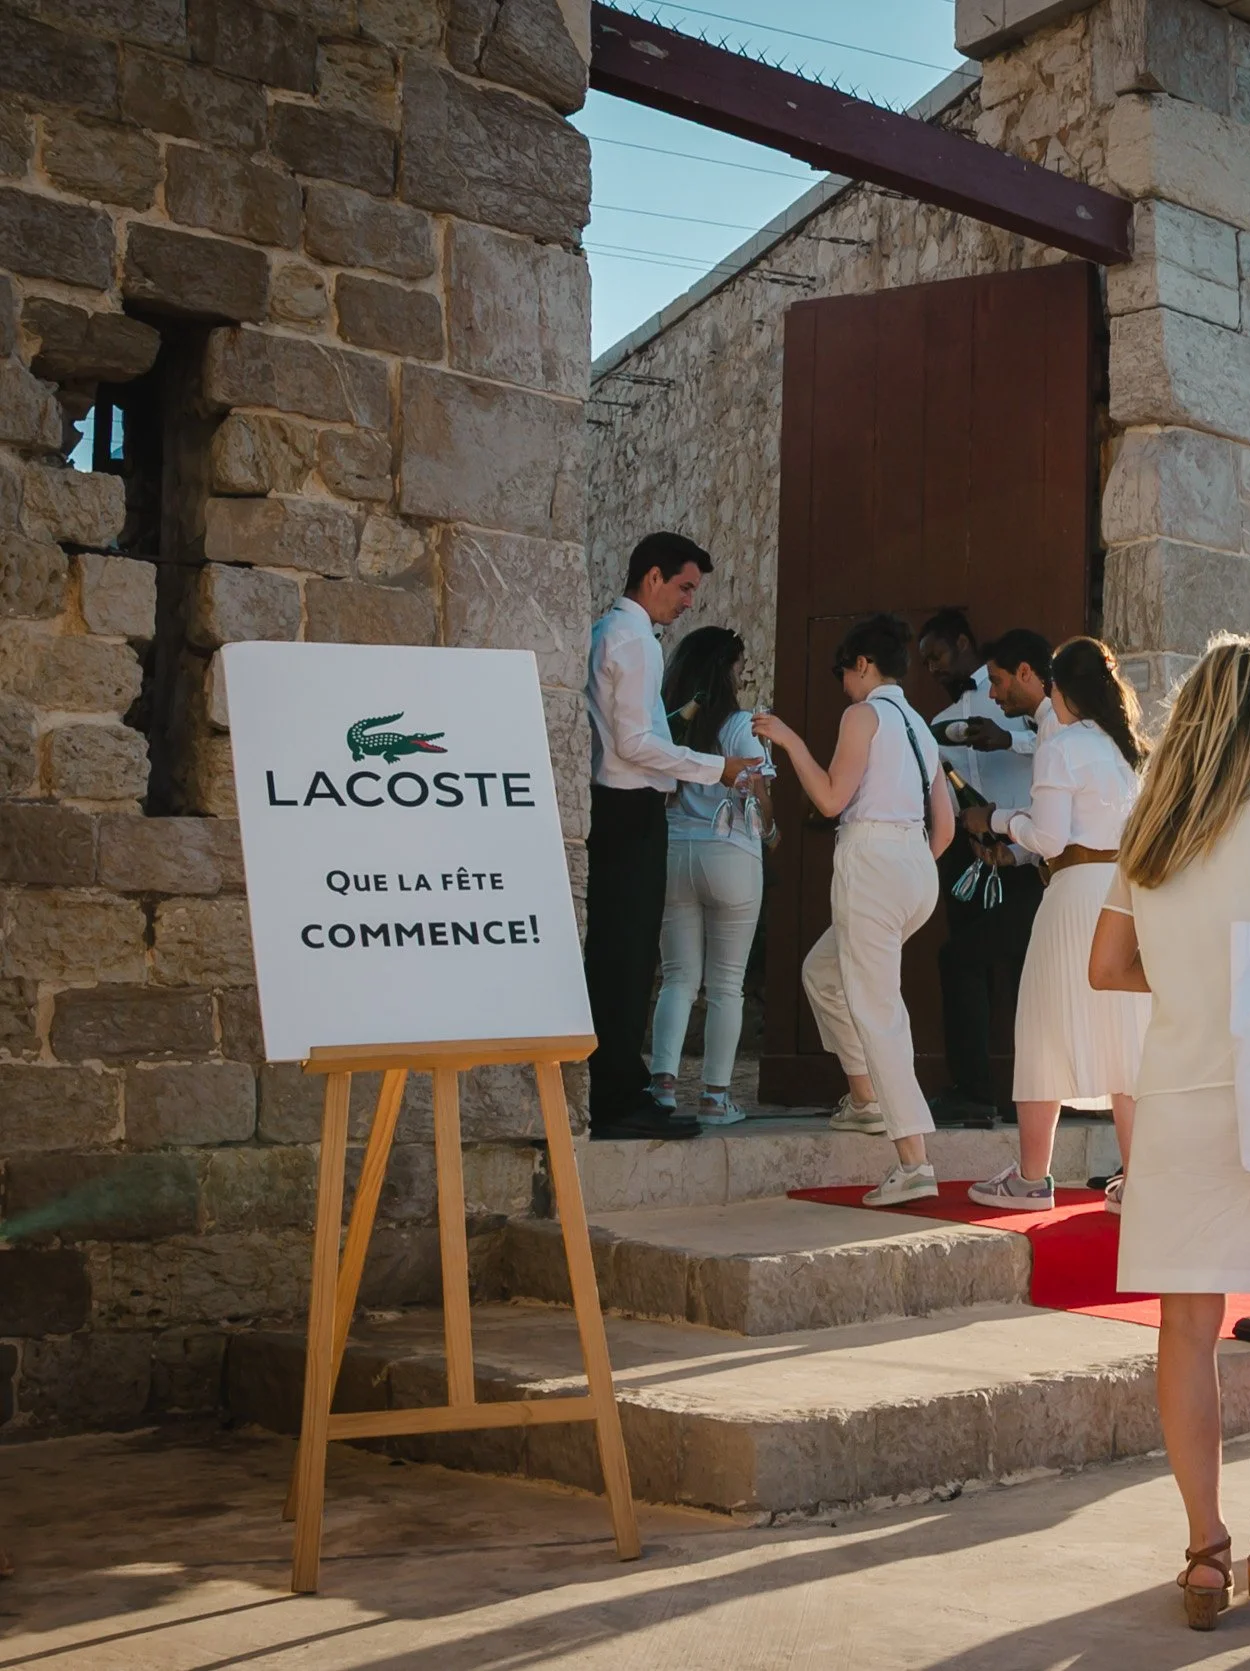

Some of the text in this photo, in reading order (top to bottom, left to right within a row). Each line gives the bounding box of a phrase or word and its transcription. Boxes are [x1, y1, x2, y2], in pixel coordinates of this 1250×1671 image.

[265, 770, 536, 807] LACOSTE
[398, 873, 432, 892] LA
[440, 866, 505, 892] FÊTE
[300, 914, 542, 949] COMMENCE!
